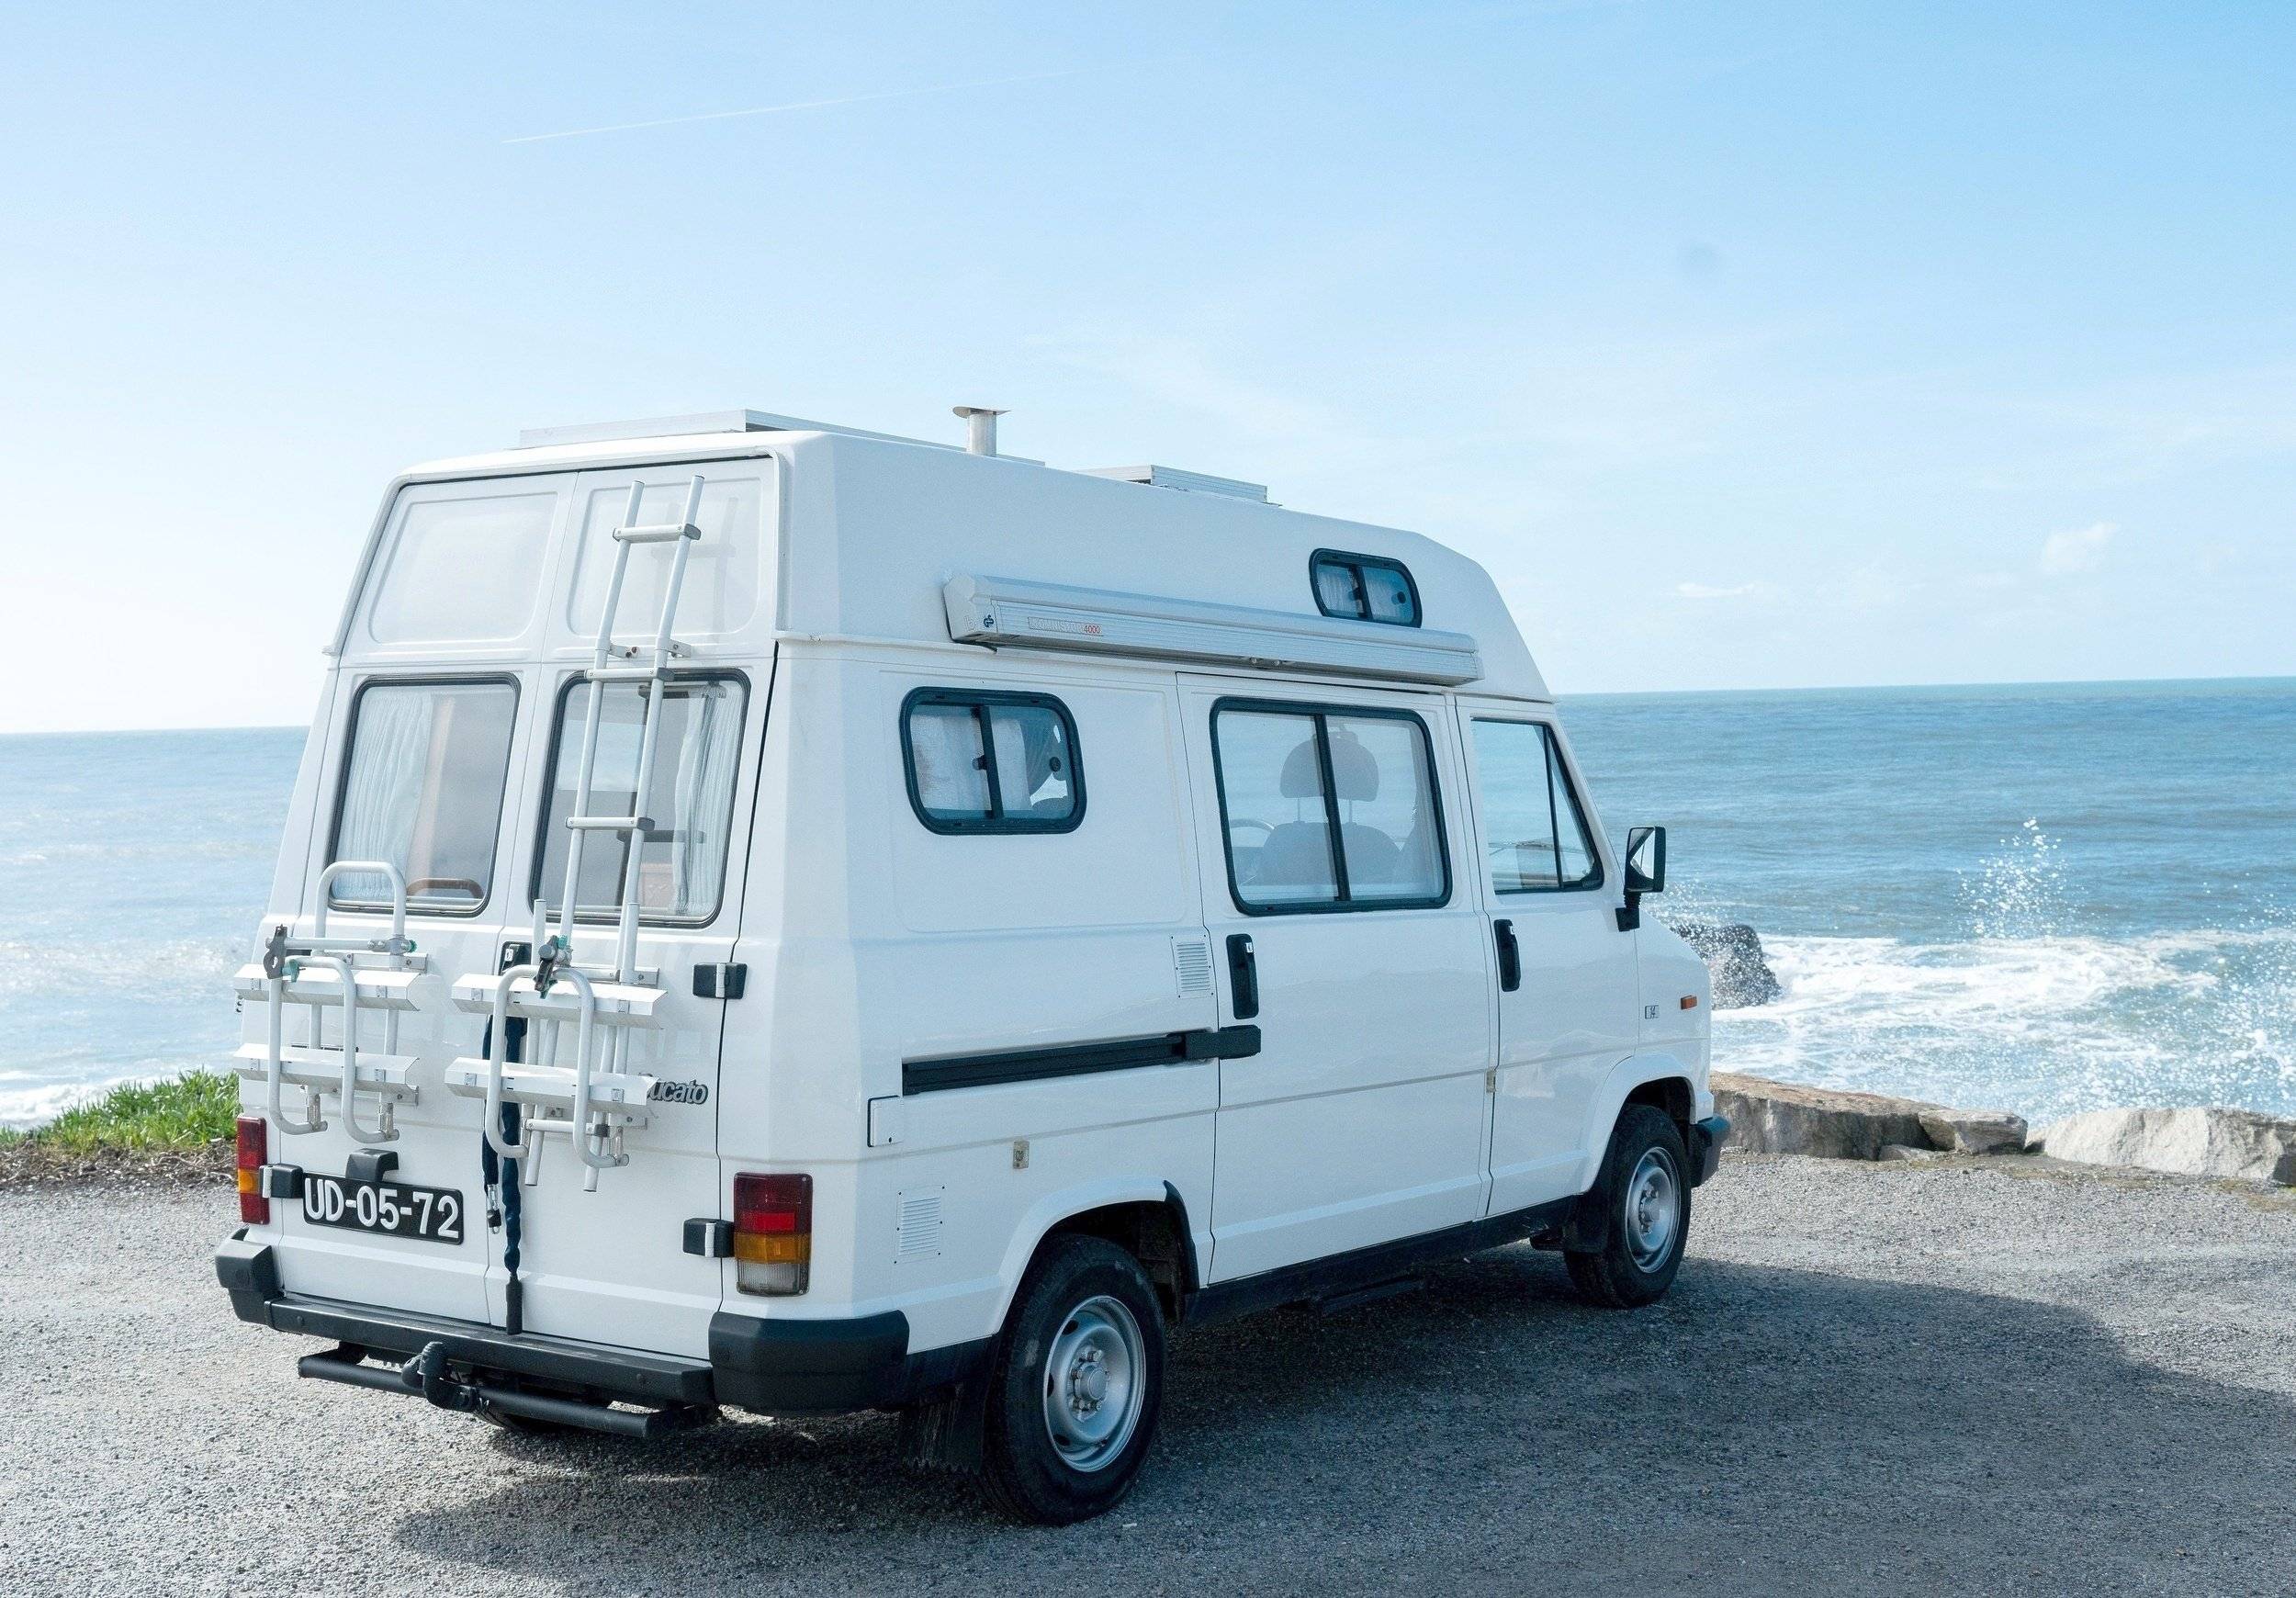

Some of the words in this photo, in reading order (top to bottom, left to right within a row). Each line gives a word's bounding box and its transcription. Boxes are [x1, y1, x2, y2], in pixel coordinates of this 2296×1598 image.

[1083, 625, 1100, 635] 4000
[641, 1074, 708, 1104] ucato
[304, 1177, 459, 1239] UD-05-72
